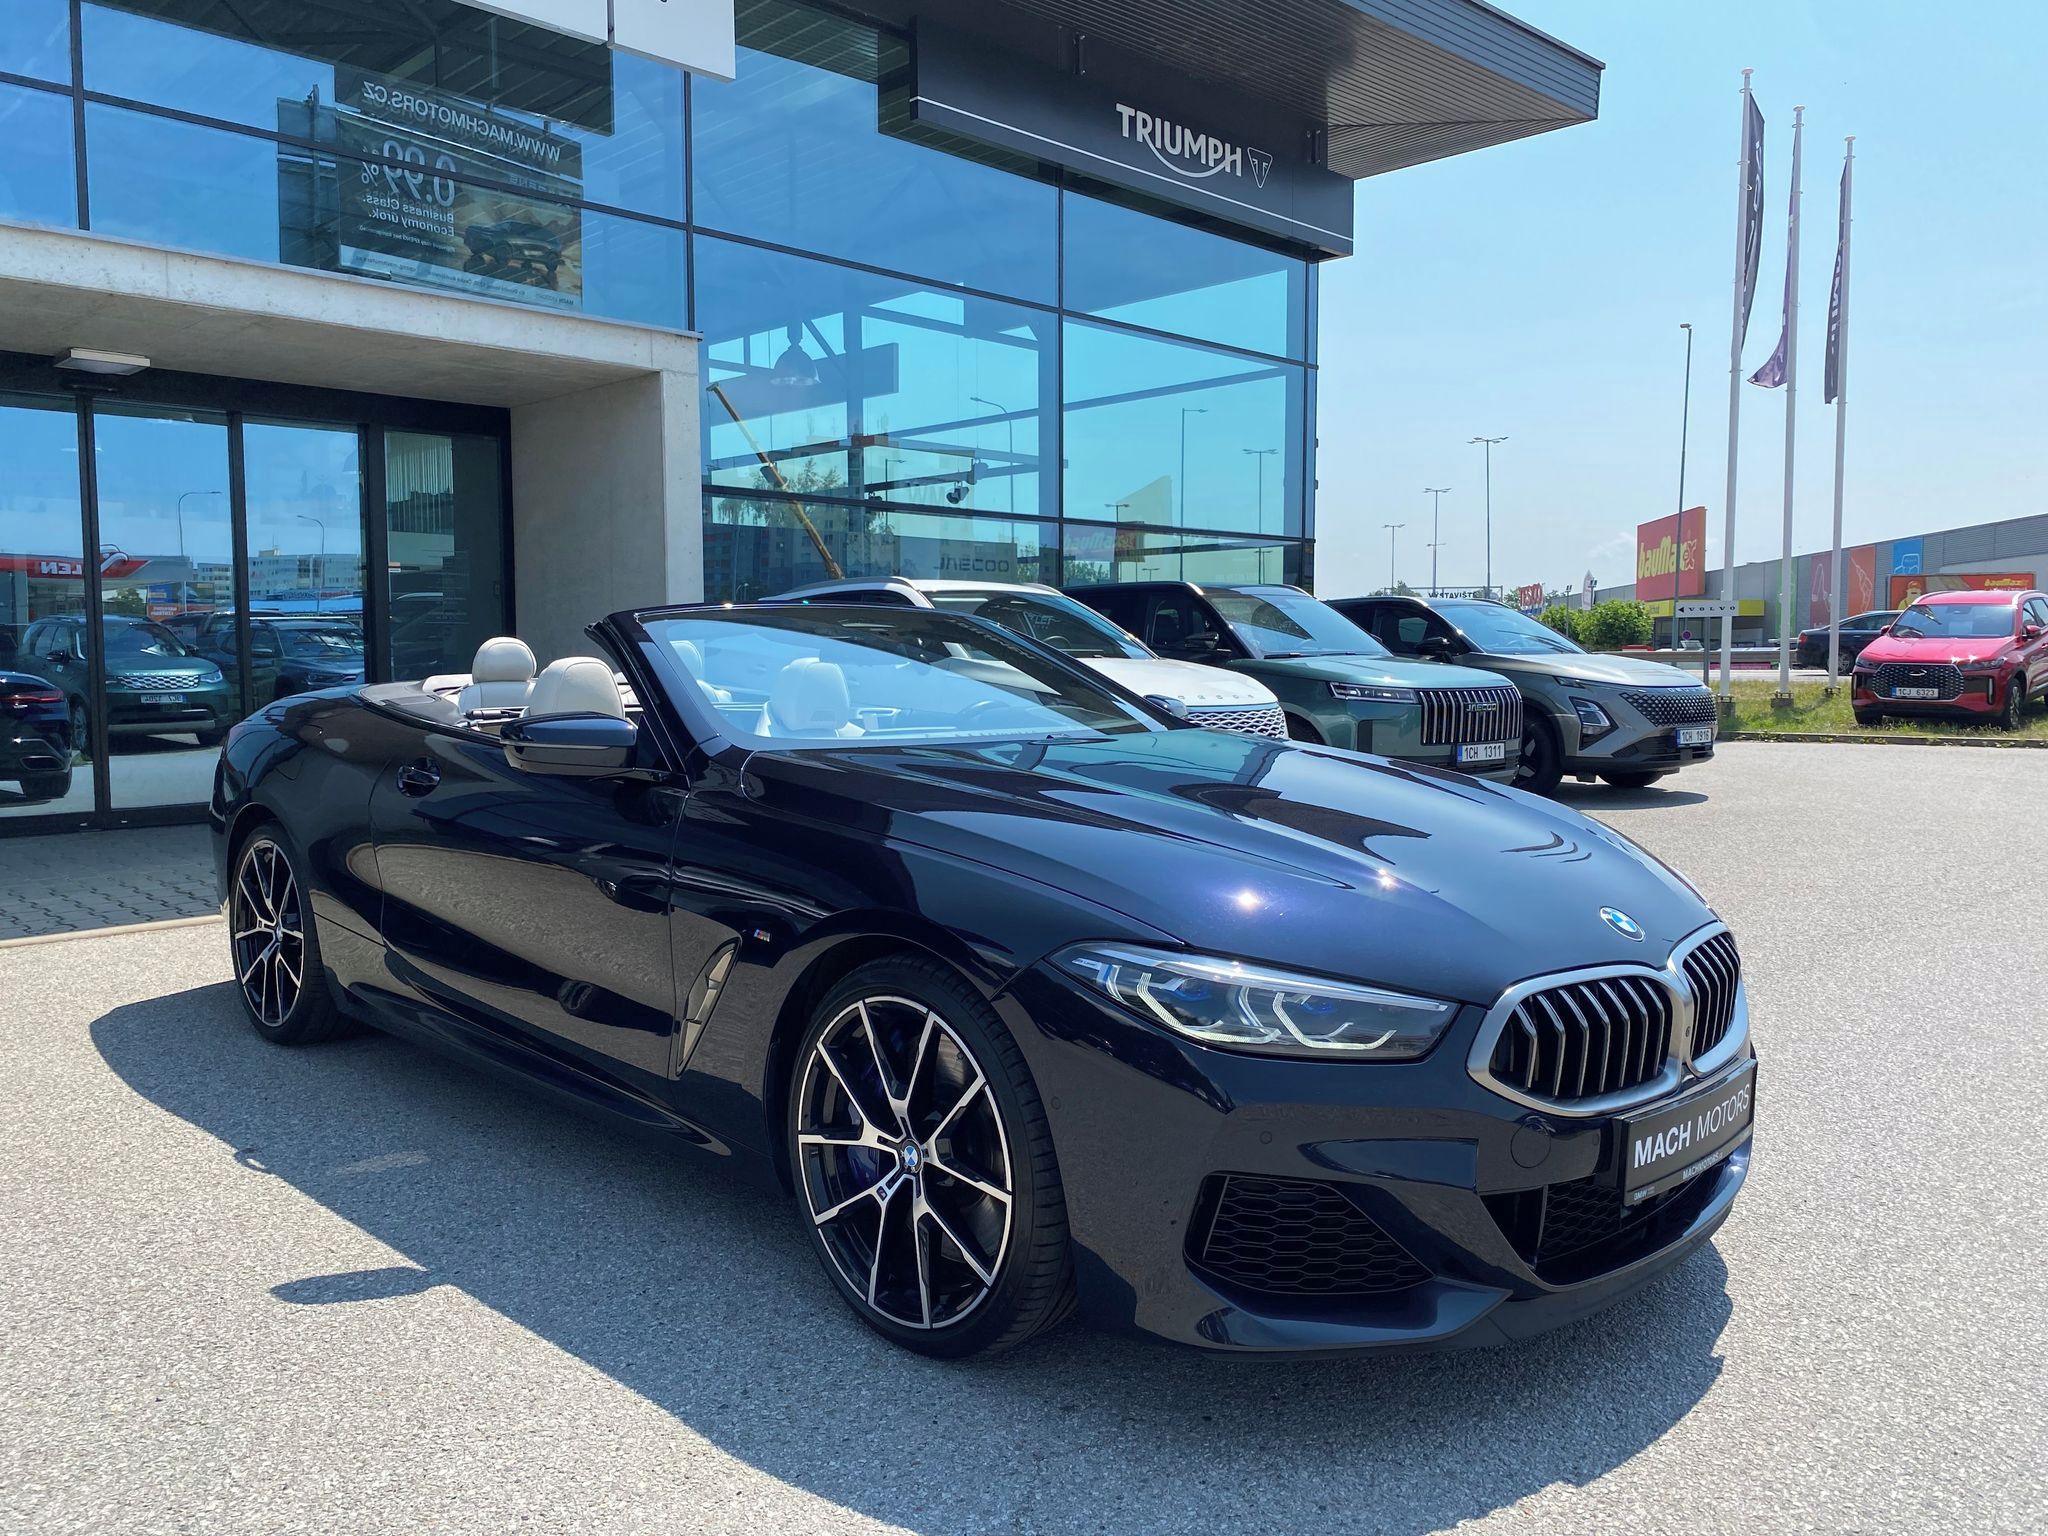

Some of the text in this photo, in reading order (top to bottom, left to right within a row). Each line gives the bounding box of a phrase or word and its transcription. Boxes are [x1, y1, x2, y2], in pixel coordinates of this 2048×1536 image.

[1115, 103, 1242, 178] TRIUMPH
[934, 556, 1010, 573] JAECOO
[1682, 730, 1710, 742] 1CH 1916
[1464, 745, 1501, 760] 1CH 1311
[1634, 1083, 1750, 1169] MACH MOTORS
